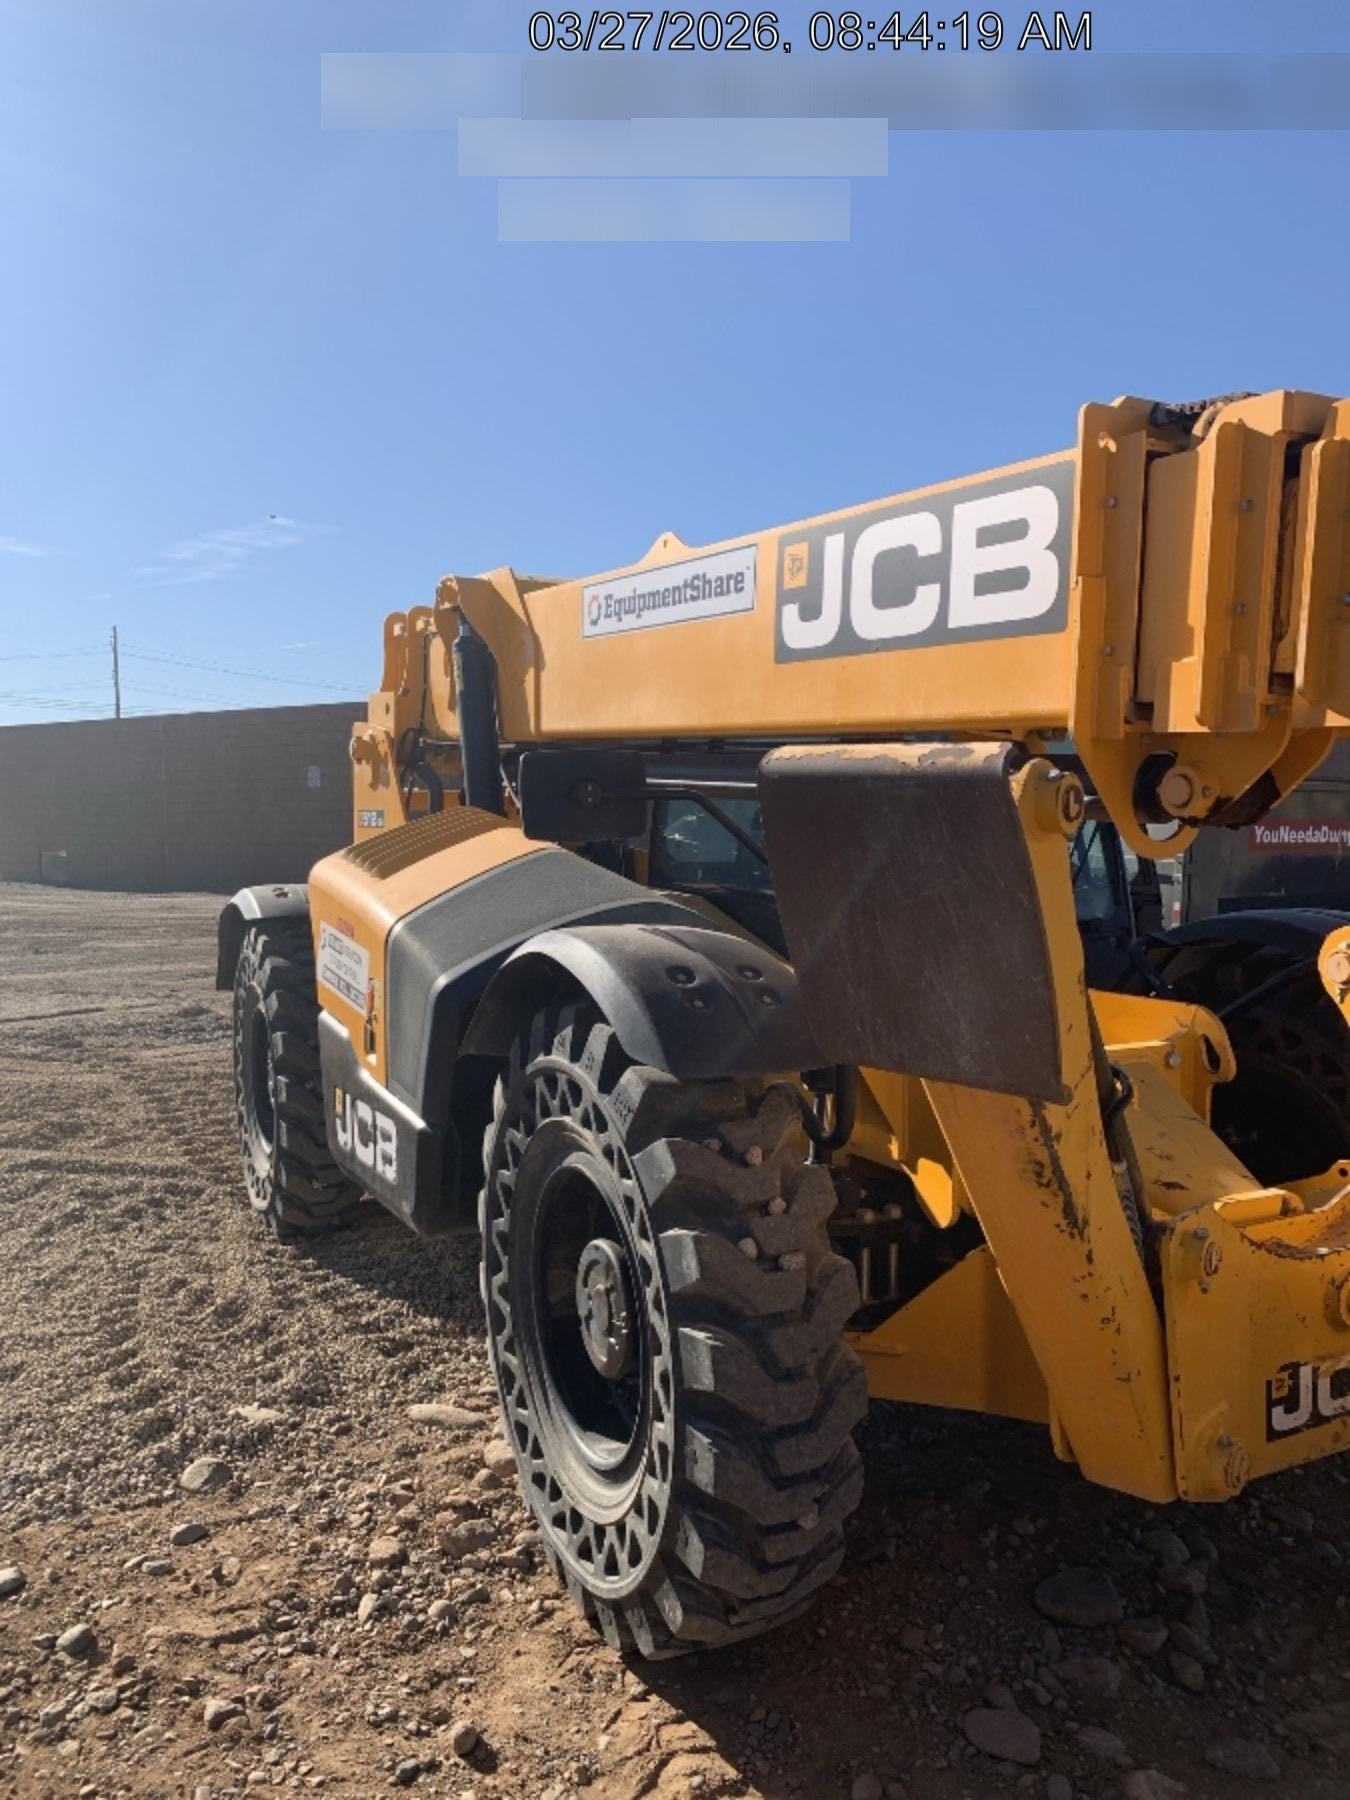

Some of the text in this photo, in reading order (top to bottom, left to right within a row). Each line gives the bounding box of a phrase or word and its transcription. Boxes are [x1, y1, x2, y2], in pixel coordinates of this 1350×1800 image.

[603, 571, 745, 622] EquipmentShare
[781, 485, 1059, 649] JCB
[335, 1093, 397, 1184] JCB
